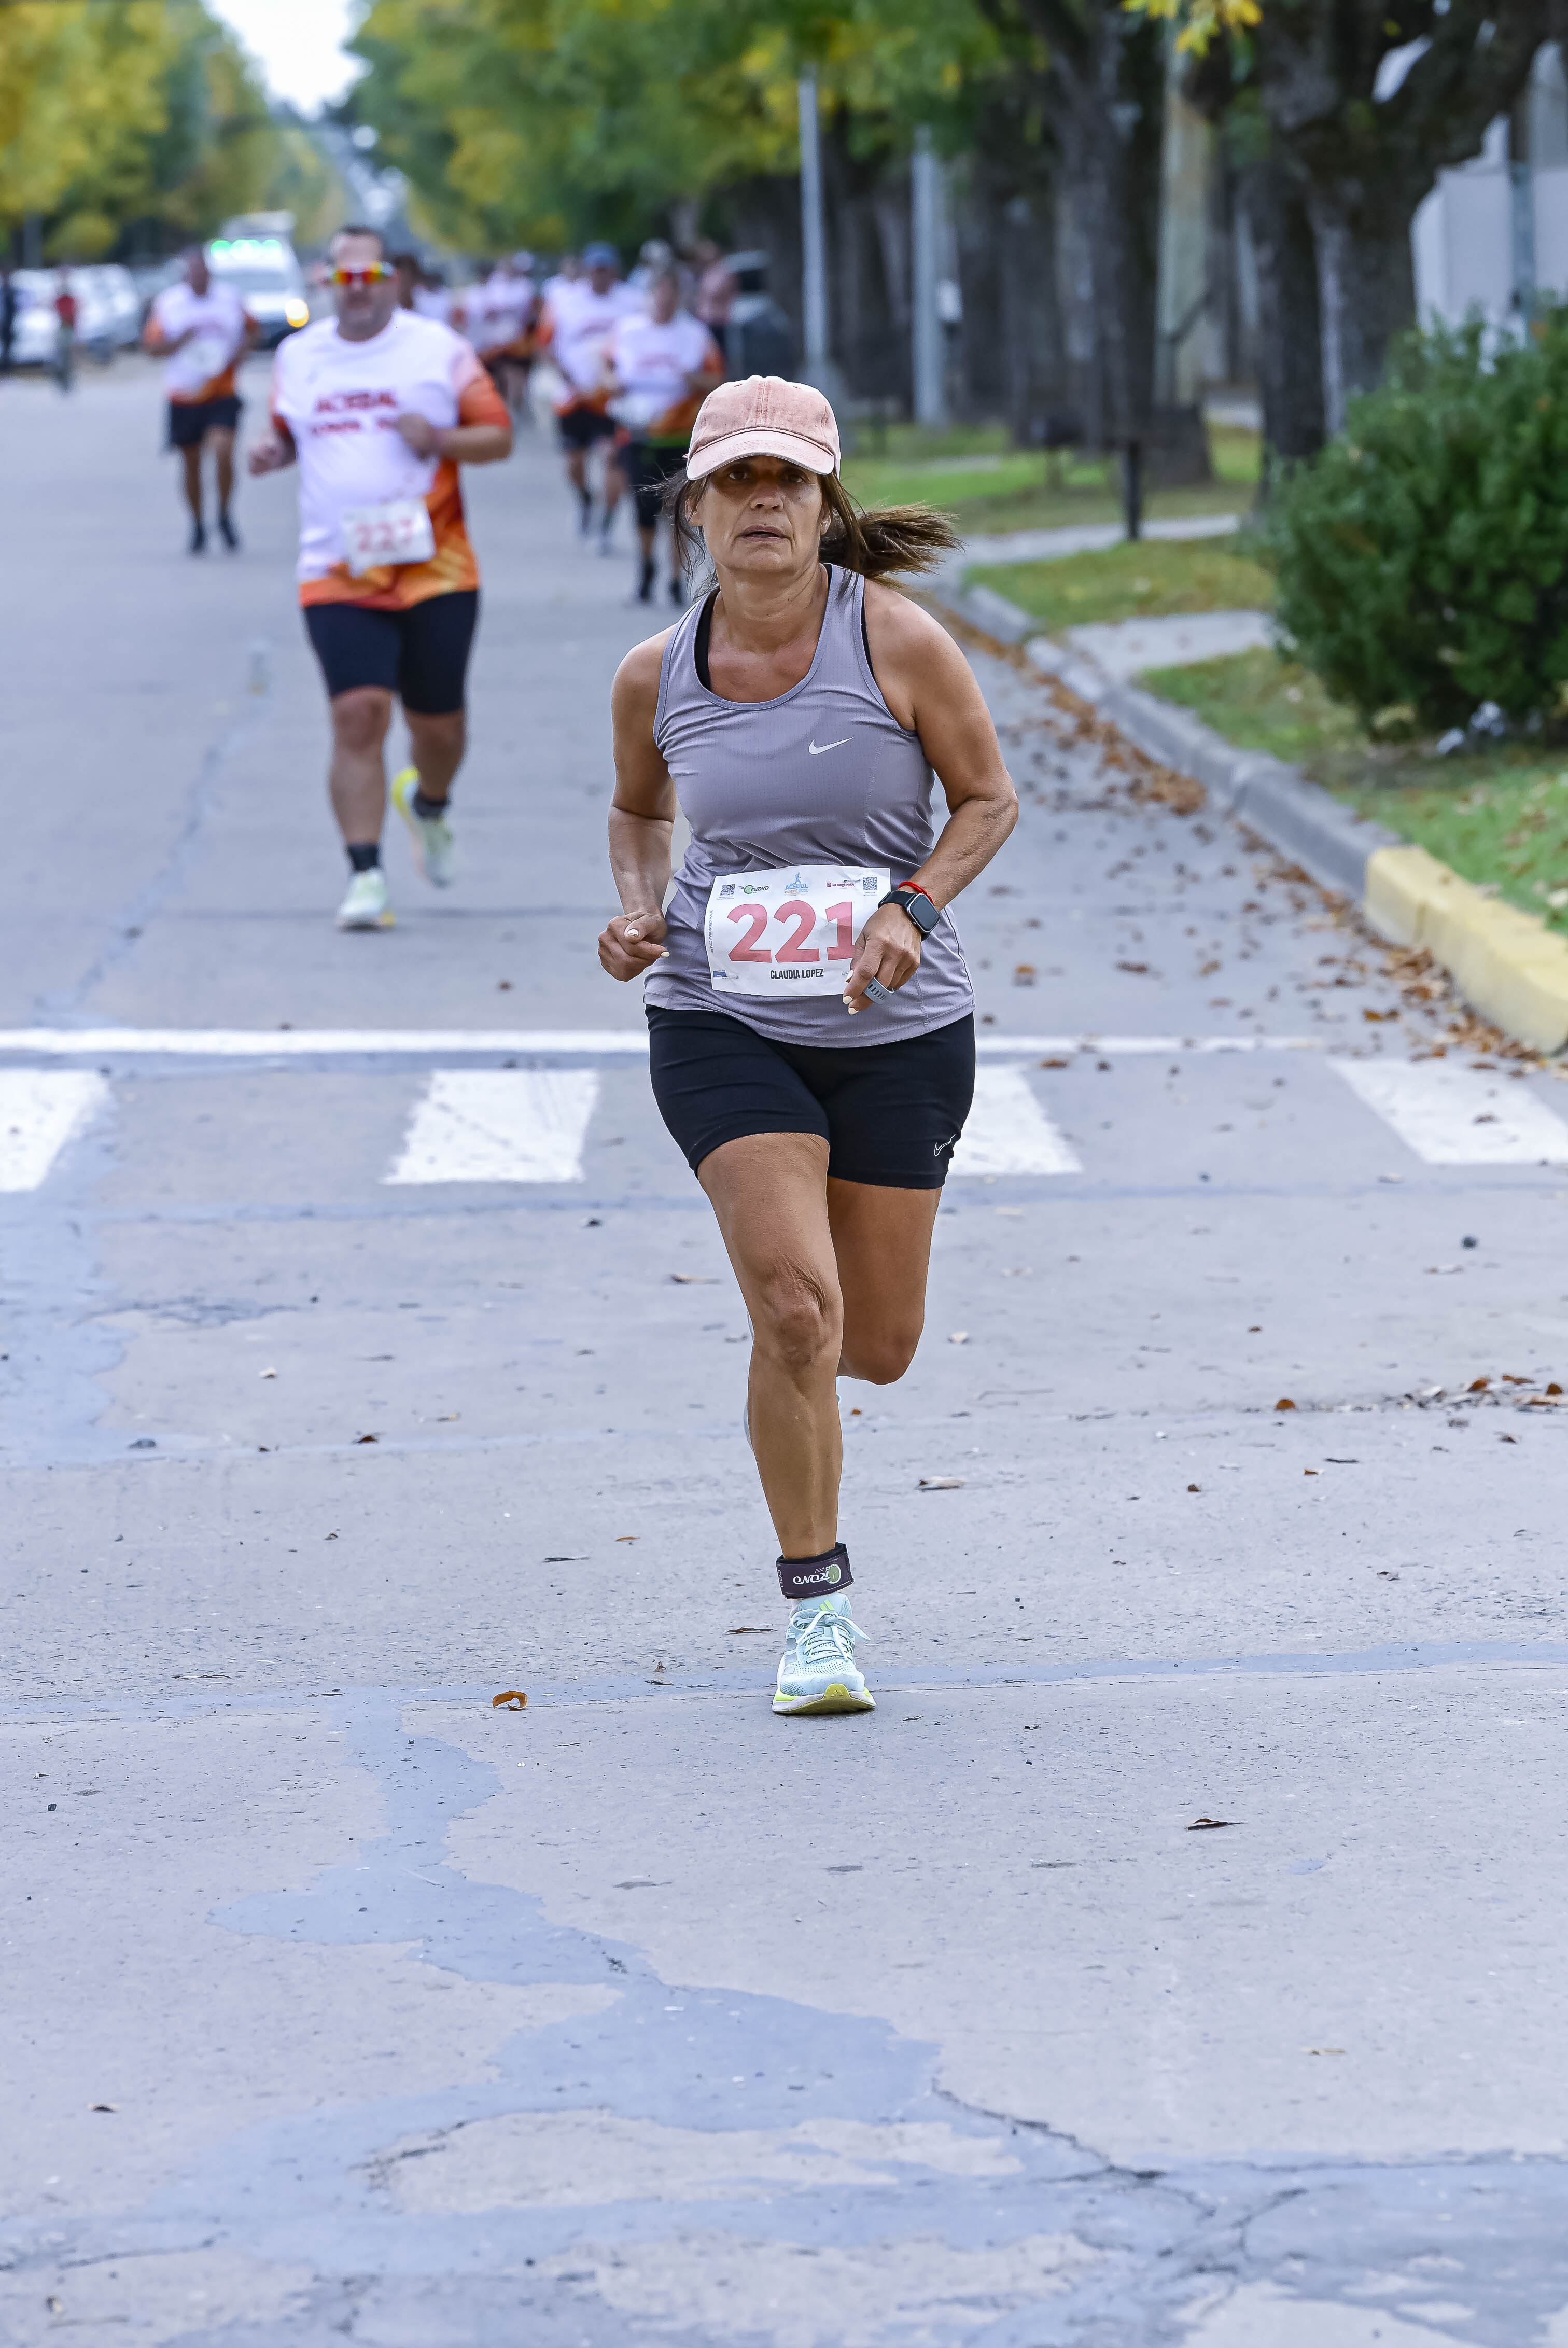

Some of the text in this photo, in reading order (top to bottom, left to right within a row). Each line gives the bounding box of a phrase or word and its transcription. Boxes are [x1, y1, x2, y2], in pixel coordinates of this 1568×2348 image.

[727, 900, 853, 963] 221
[770, 968, 824, 979] CLAUDIA LOPEZ
